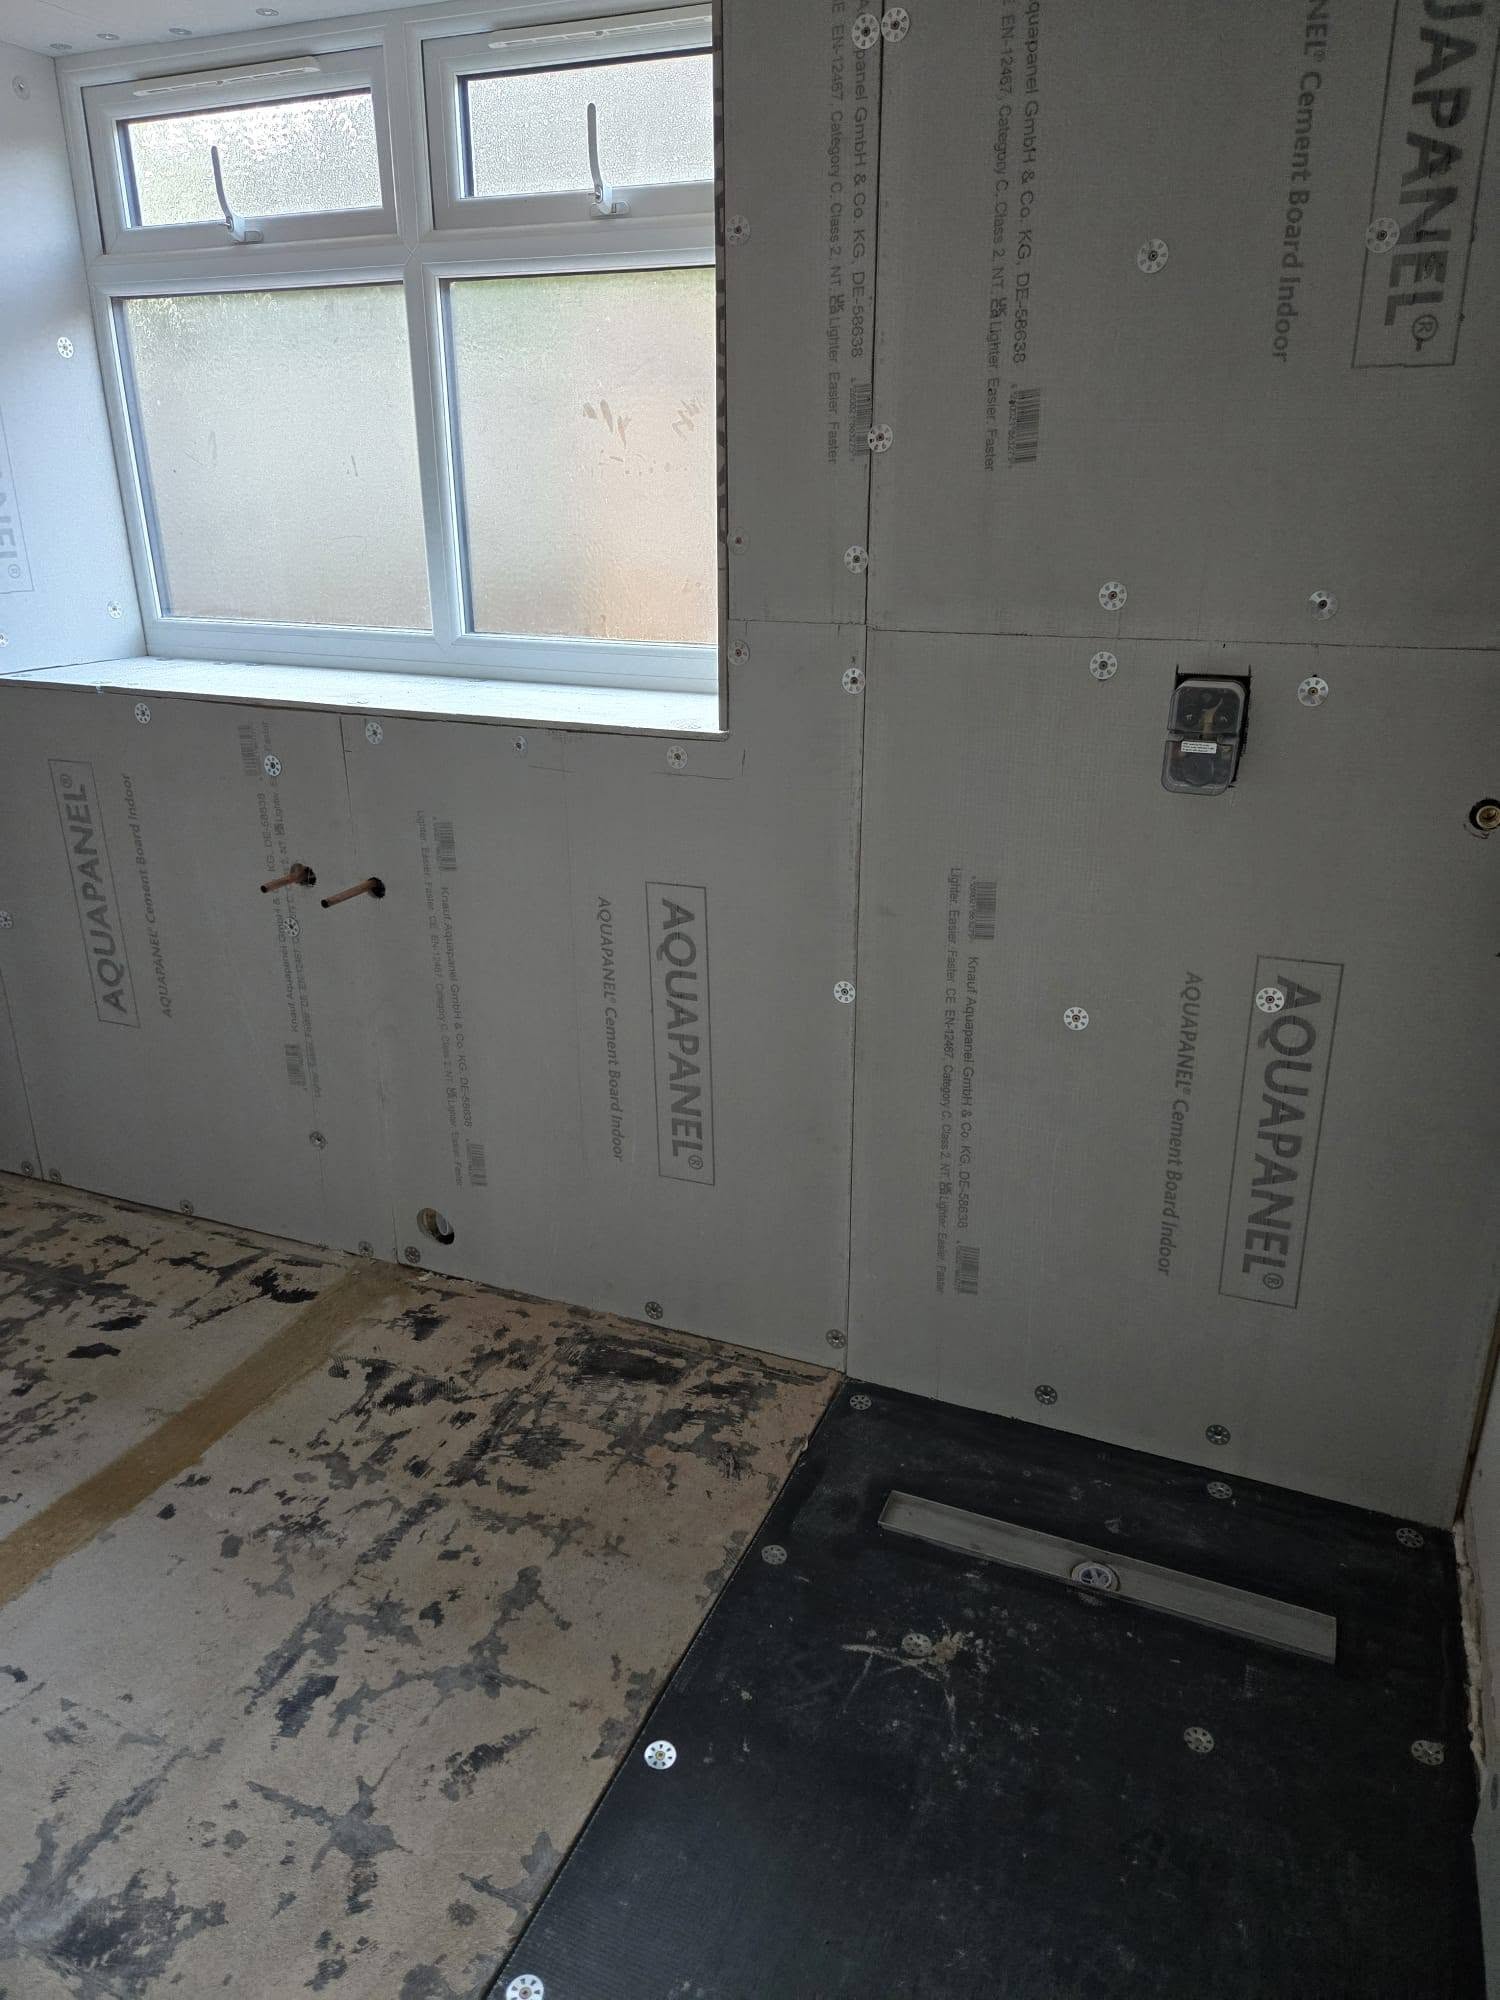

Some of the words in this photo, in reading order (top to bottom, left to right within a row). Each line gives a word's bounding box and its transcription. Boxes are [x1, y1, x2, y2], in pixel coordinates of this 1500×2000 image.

[827, 111, 843, 177] Category
[854, 106, 868, 166] GmbH
[994, 105, 1013, 175] Category
[1022, 100, 1039, 163] GmbH
[1290, 71, 1323, 182] Cement
[854, 174, 866, 185] &
[1022, 169, 1035, 185] &
[829, 203, 842, 242] Class
[853, 193, 866, 223] Co.
[993, 202, 1009, 244] Class
[1020, 190, 1034, 222] Co.
[1280, 190, 1312, 269] Board
[1016, 230, 1032, 265] KG,
[851, 272, 865, 358] DE-58638
[1013, 272, 1031, 364] DE-58638
[1270, 276, 1303, 362] Indoor
[828, 422, 840, 464] Faster
[984, 429, 998, 472] Faster
[121, 773, 137, 820] Indoor
[129, 824, 146, 865] Board
[60, 774, 127, 1013] AQUAPANEL®
[139, 870, 156, 923] Cement
[439, 887, 454, 919] Knauf
[442, 924, 460, 981] Aquapanel
[966, 956, 980, 995] Knauf
[450, 983, 462, 1019] GmbH
[604, 1007, 620, 1065] Cement
[656, 898, 705, 1170] AQUAPANEL®
[962, 997, 978, 1063] Aquapanel
[608, 1069, 625, 1112] Board
[939, 1064, 954, 1107] Category
[960, 1066, 975, 1106] GmbH
[960, 1109, 974, 1118] &
[1166, 1099, 1190, 1166] Cement
[1241, 975, 1322, 1290] AQUAPANEL®
[611, 1115, 626, 1162] Indoor
[940, 1124, 951, 1152] Class
[1162, 1170, 1183, 1219] Board
[1157, 1220, 1180, 1277] Indoor
